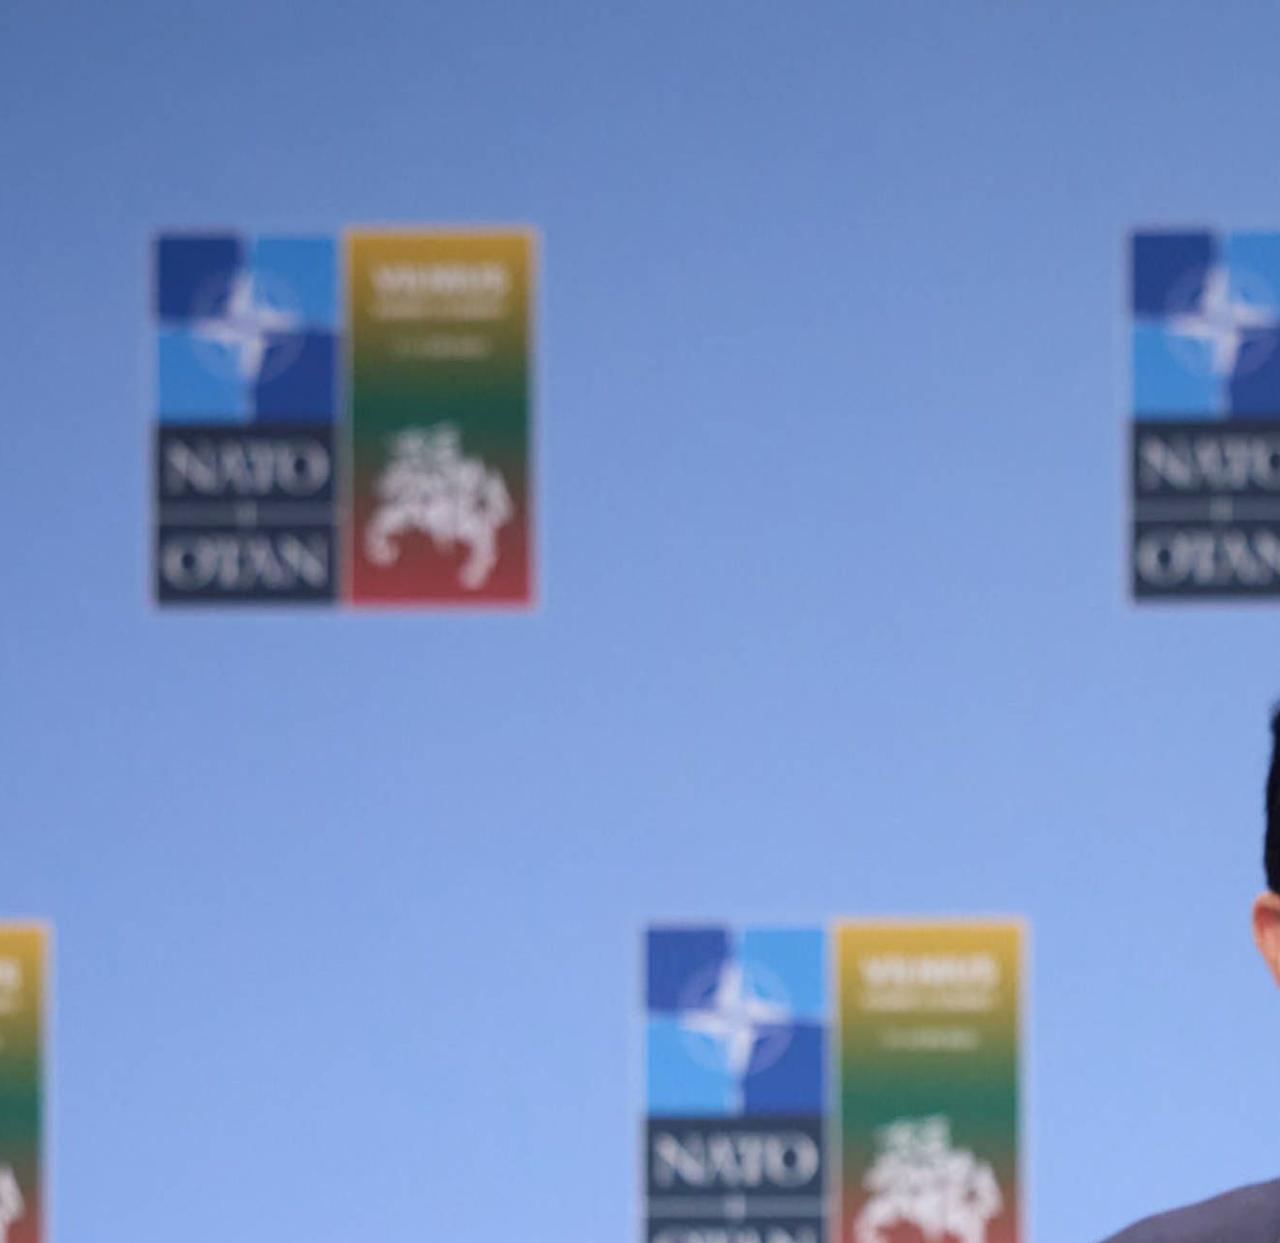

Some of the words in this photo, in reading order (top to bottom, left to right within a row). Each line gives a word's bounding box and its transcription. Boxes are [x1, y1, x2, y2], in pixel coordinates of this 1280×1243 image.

[165, 440, 330, 496] NATO
[162, 533, 329, 590] OTAN
[652, 1130, 819, 1188] NATO
